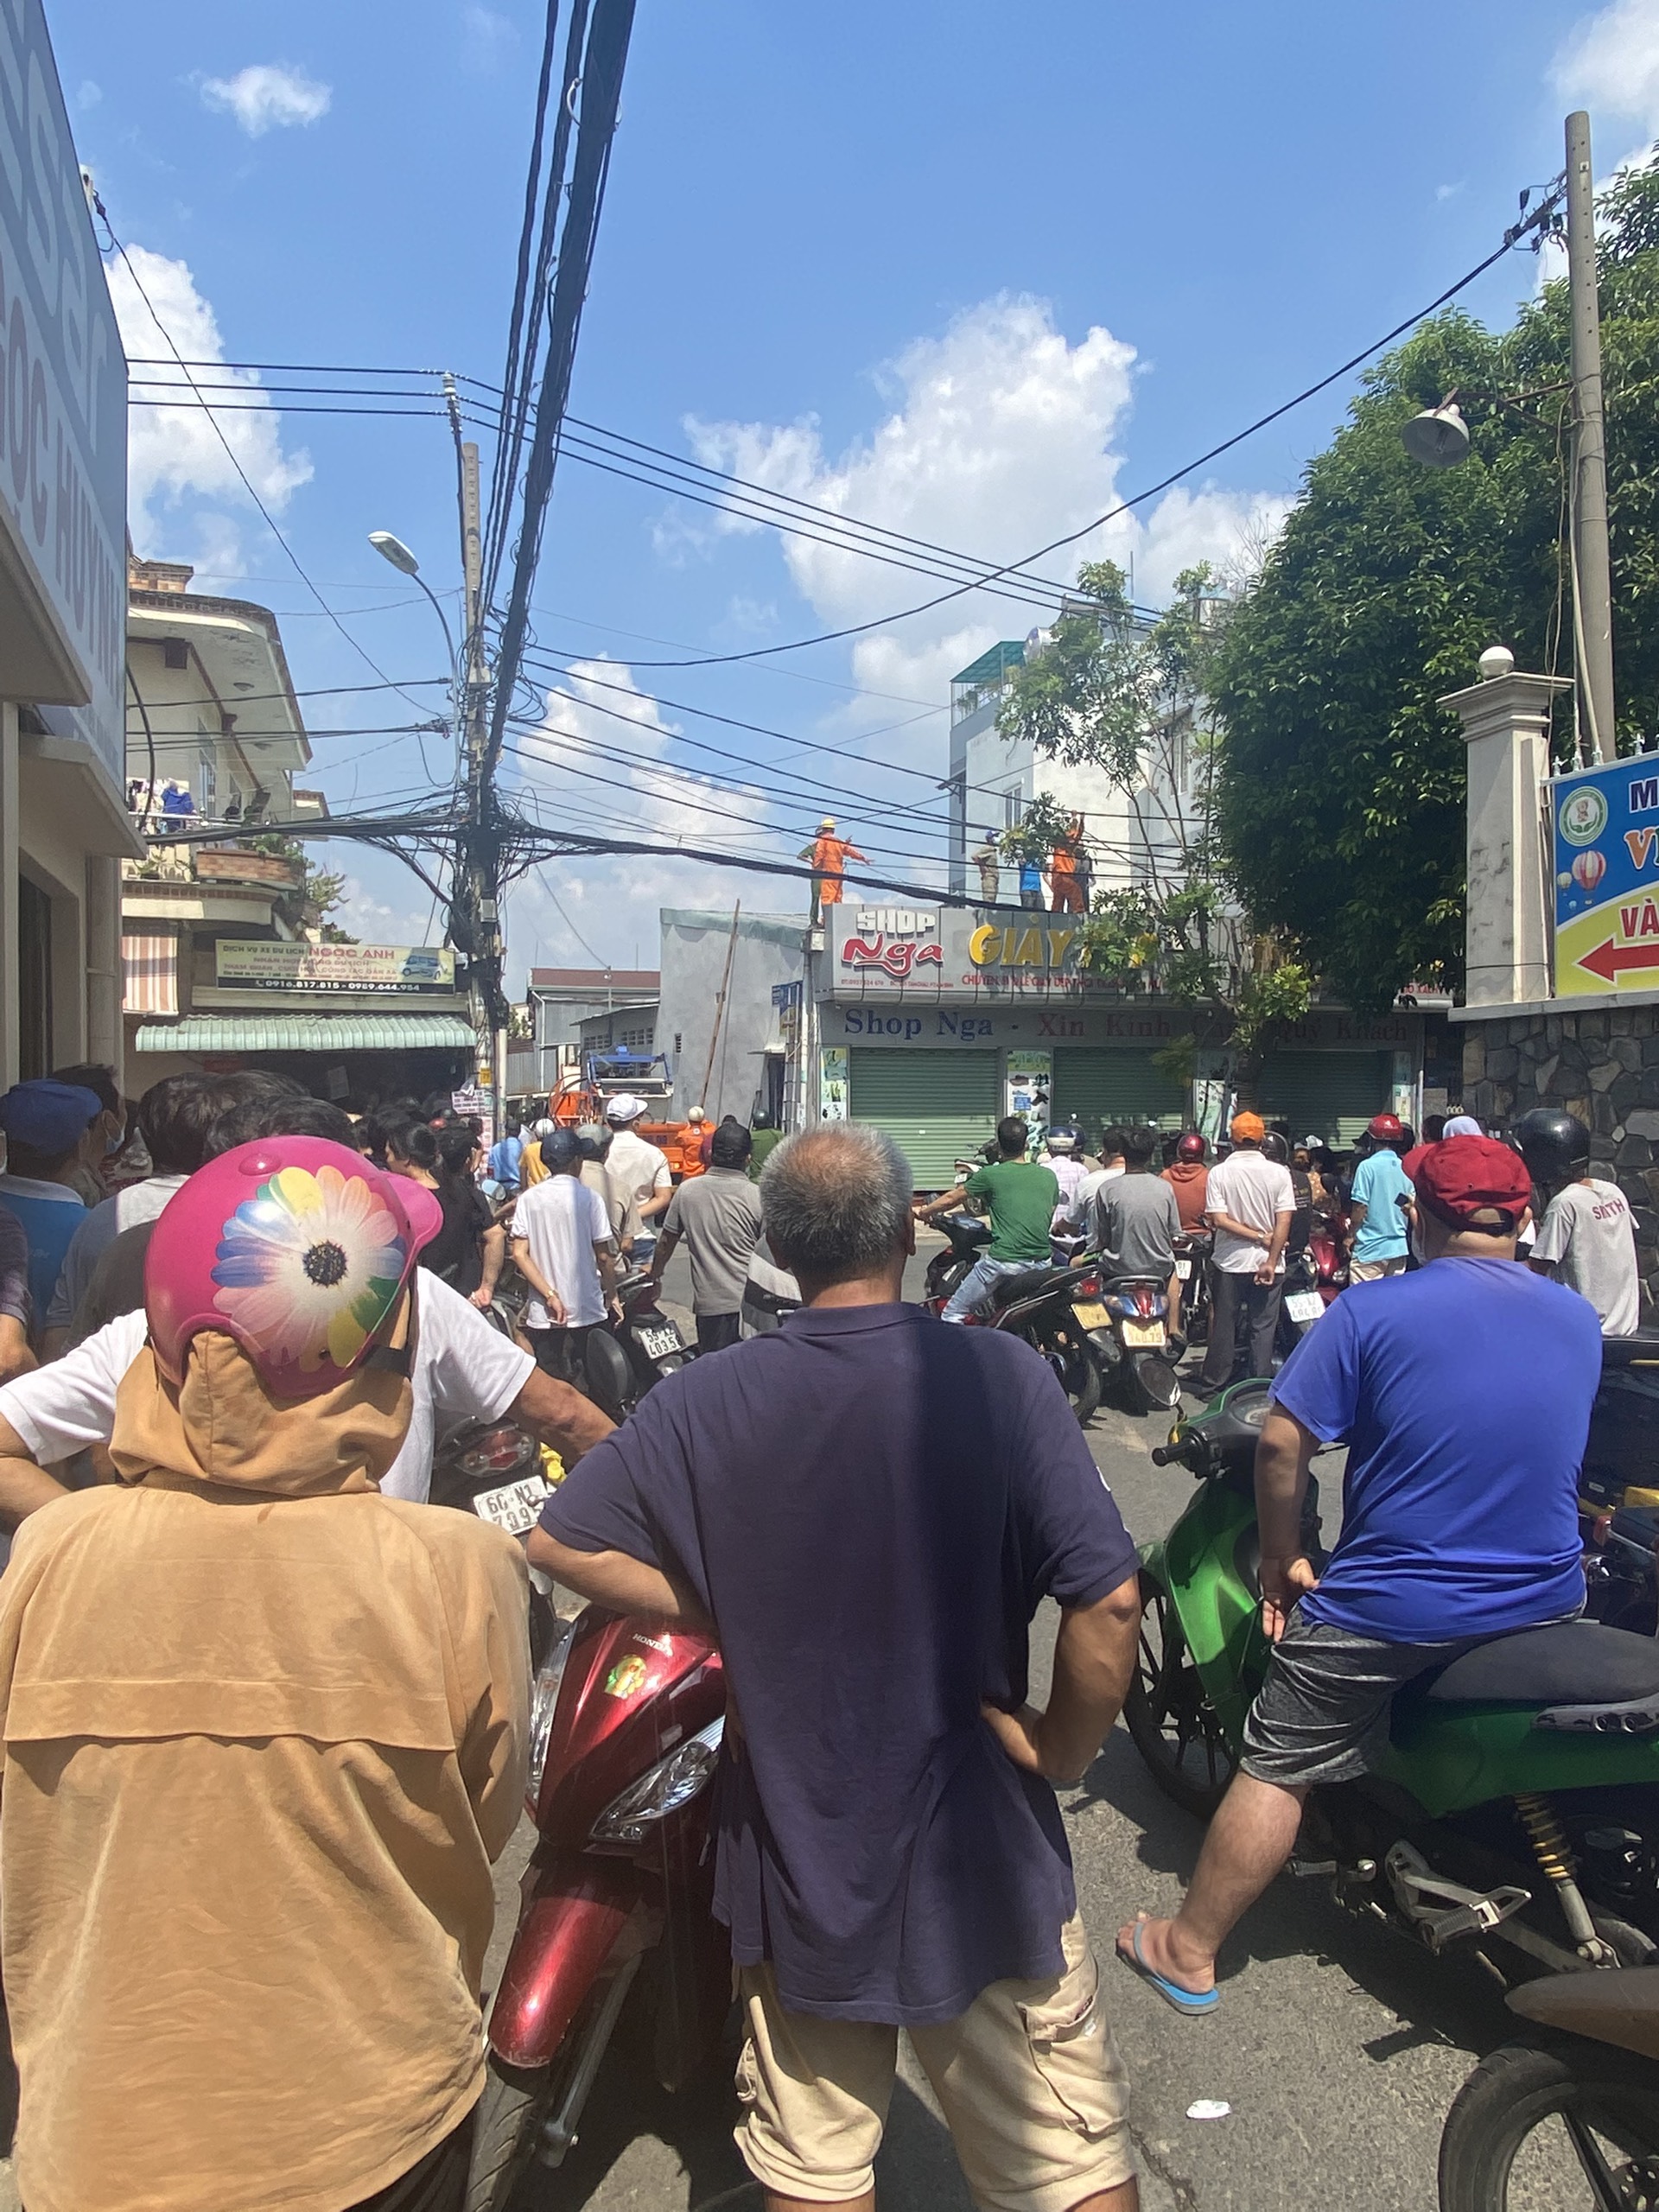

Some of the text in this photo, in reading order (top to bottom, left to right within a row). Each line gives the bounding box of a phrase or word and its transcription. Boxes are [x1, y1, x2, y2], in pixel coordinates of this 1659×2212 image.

[856, 909, 936, 934] SHOP
[361, 948, 395, 960] ANH
[842, 932, 944, 976] Nga
[844, 1007, 922, 1040] Shop
[936, 1010, 995, 1042] Nga
[1037, 1012, 1085, 1037] Xin
